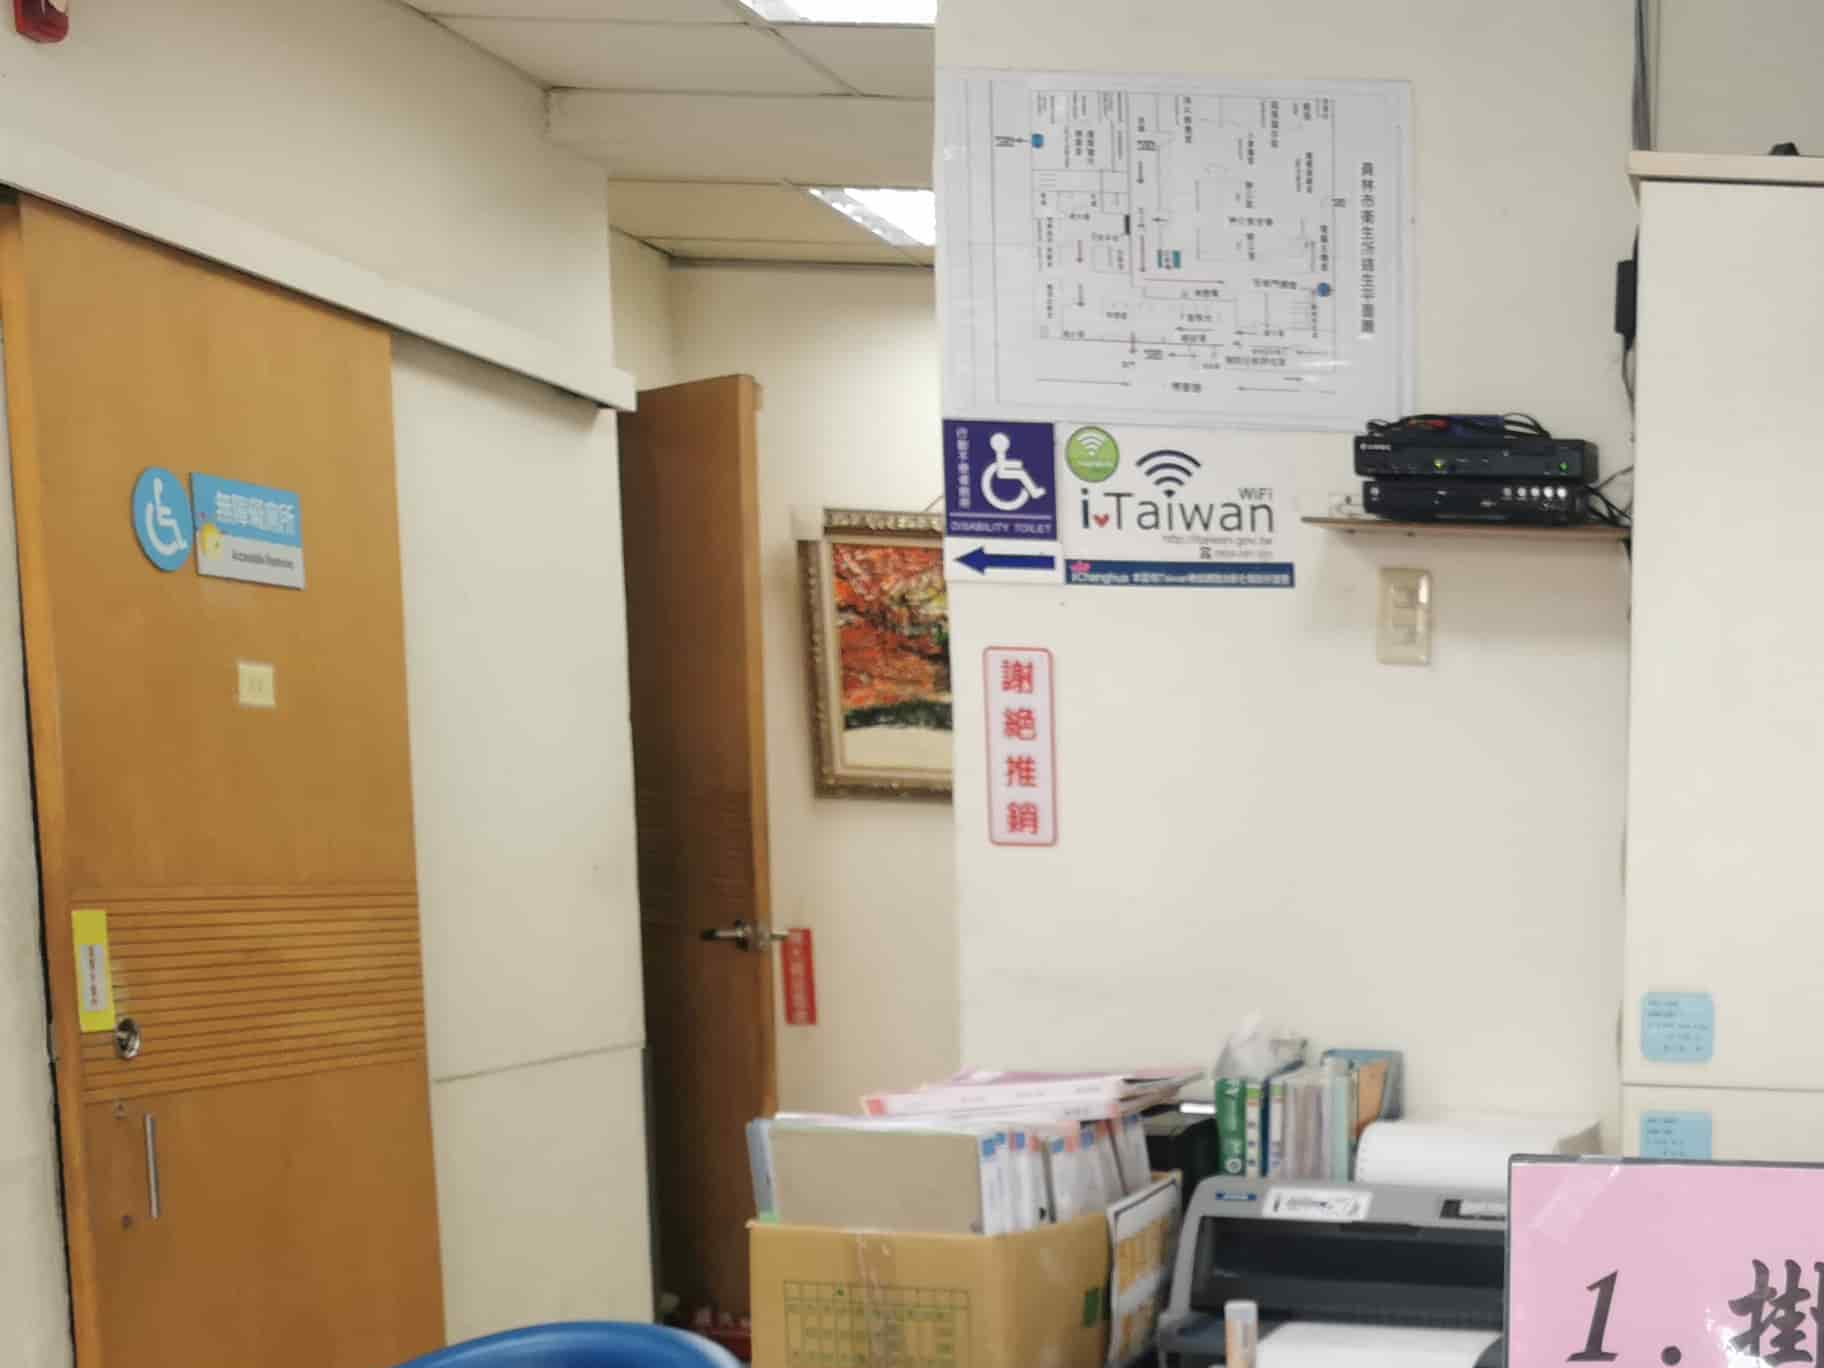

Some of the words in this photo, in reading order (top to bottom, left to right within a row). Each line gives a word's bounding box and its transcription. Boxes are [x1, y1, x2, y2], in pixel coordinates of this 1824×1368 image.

[950, 519, 1009, 533] DISABILITY
[1014, 522, 1052, 534] TOILET
[1001, 659, 1040, 834] 謝絕推銷
